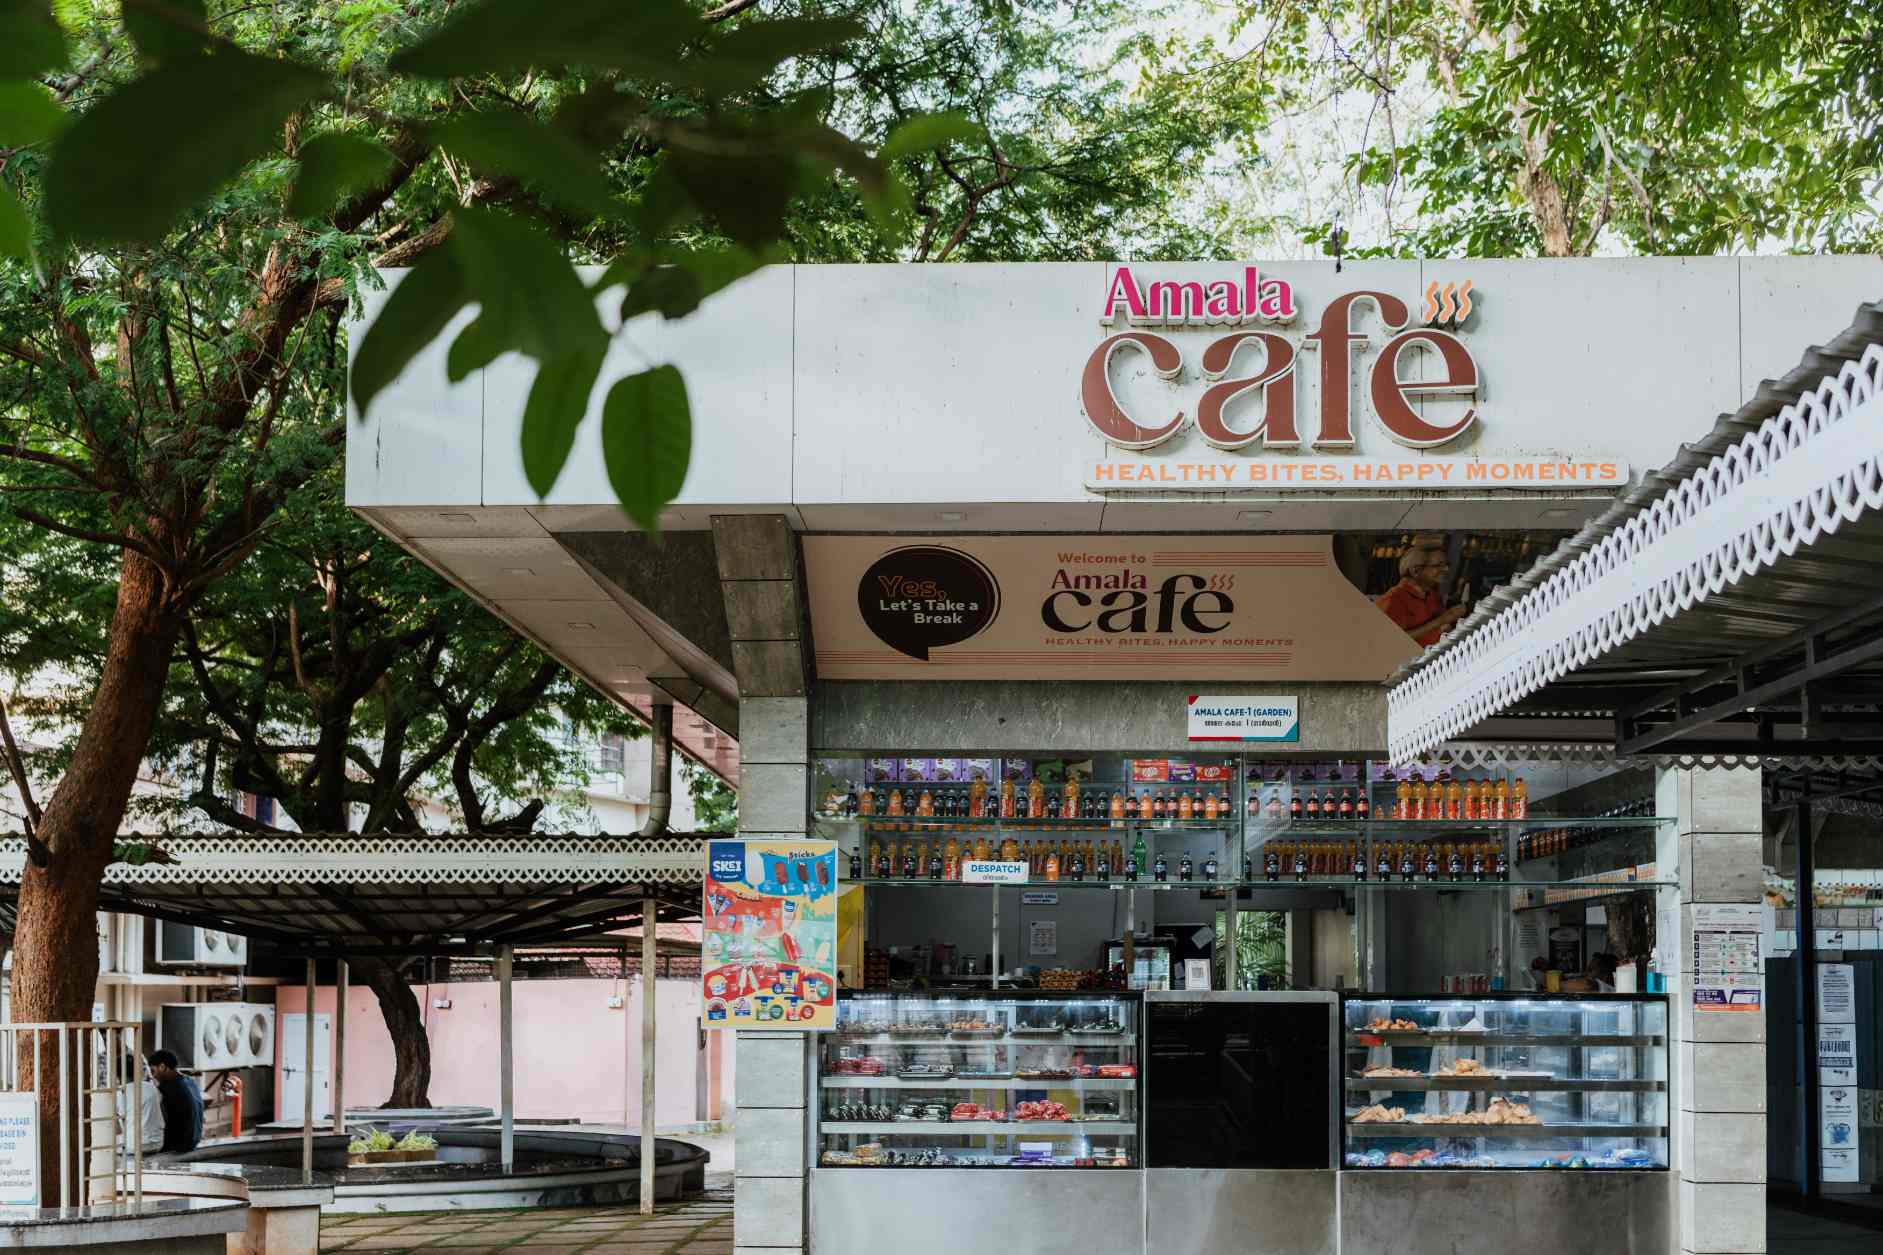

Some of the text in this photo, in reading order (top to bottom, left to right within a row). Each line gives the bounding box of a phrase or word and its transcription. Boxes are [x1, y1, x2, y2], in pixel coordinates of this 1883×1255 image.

[1104, 266, 1295, 318] Amala
[1081, 290, 1479, 449] cafe
[1095, 462, 1617, 482] HEALTHY BITES, HAPPY MOMENTS
[1057, 552, 1146, 564] Welcome to
[1051, 568, 1147, 590] Amala
[878, 575, 946, 600] Yes,
[880, 600, 979, 611] Let's Take a
[1041, 574, 1234, 633] cafe
[914, 613, 963, 624] Break
[1045, 638, 1112, 646] HEALTHY
[1168, 638, 1216, 646] HAPPY
[1221, 638, 1294, 646] MOMENTS
[1195, 708, 1222, 716] AMALA
[1253, 708, 1292, 717] (GARDEN)
[713, 860, 742, 872] SKEI
[971, 864, 1021, 873] DESPATCH
